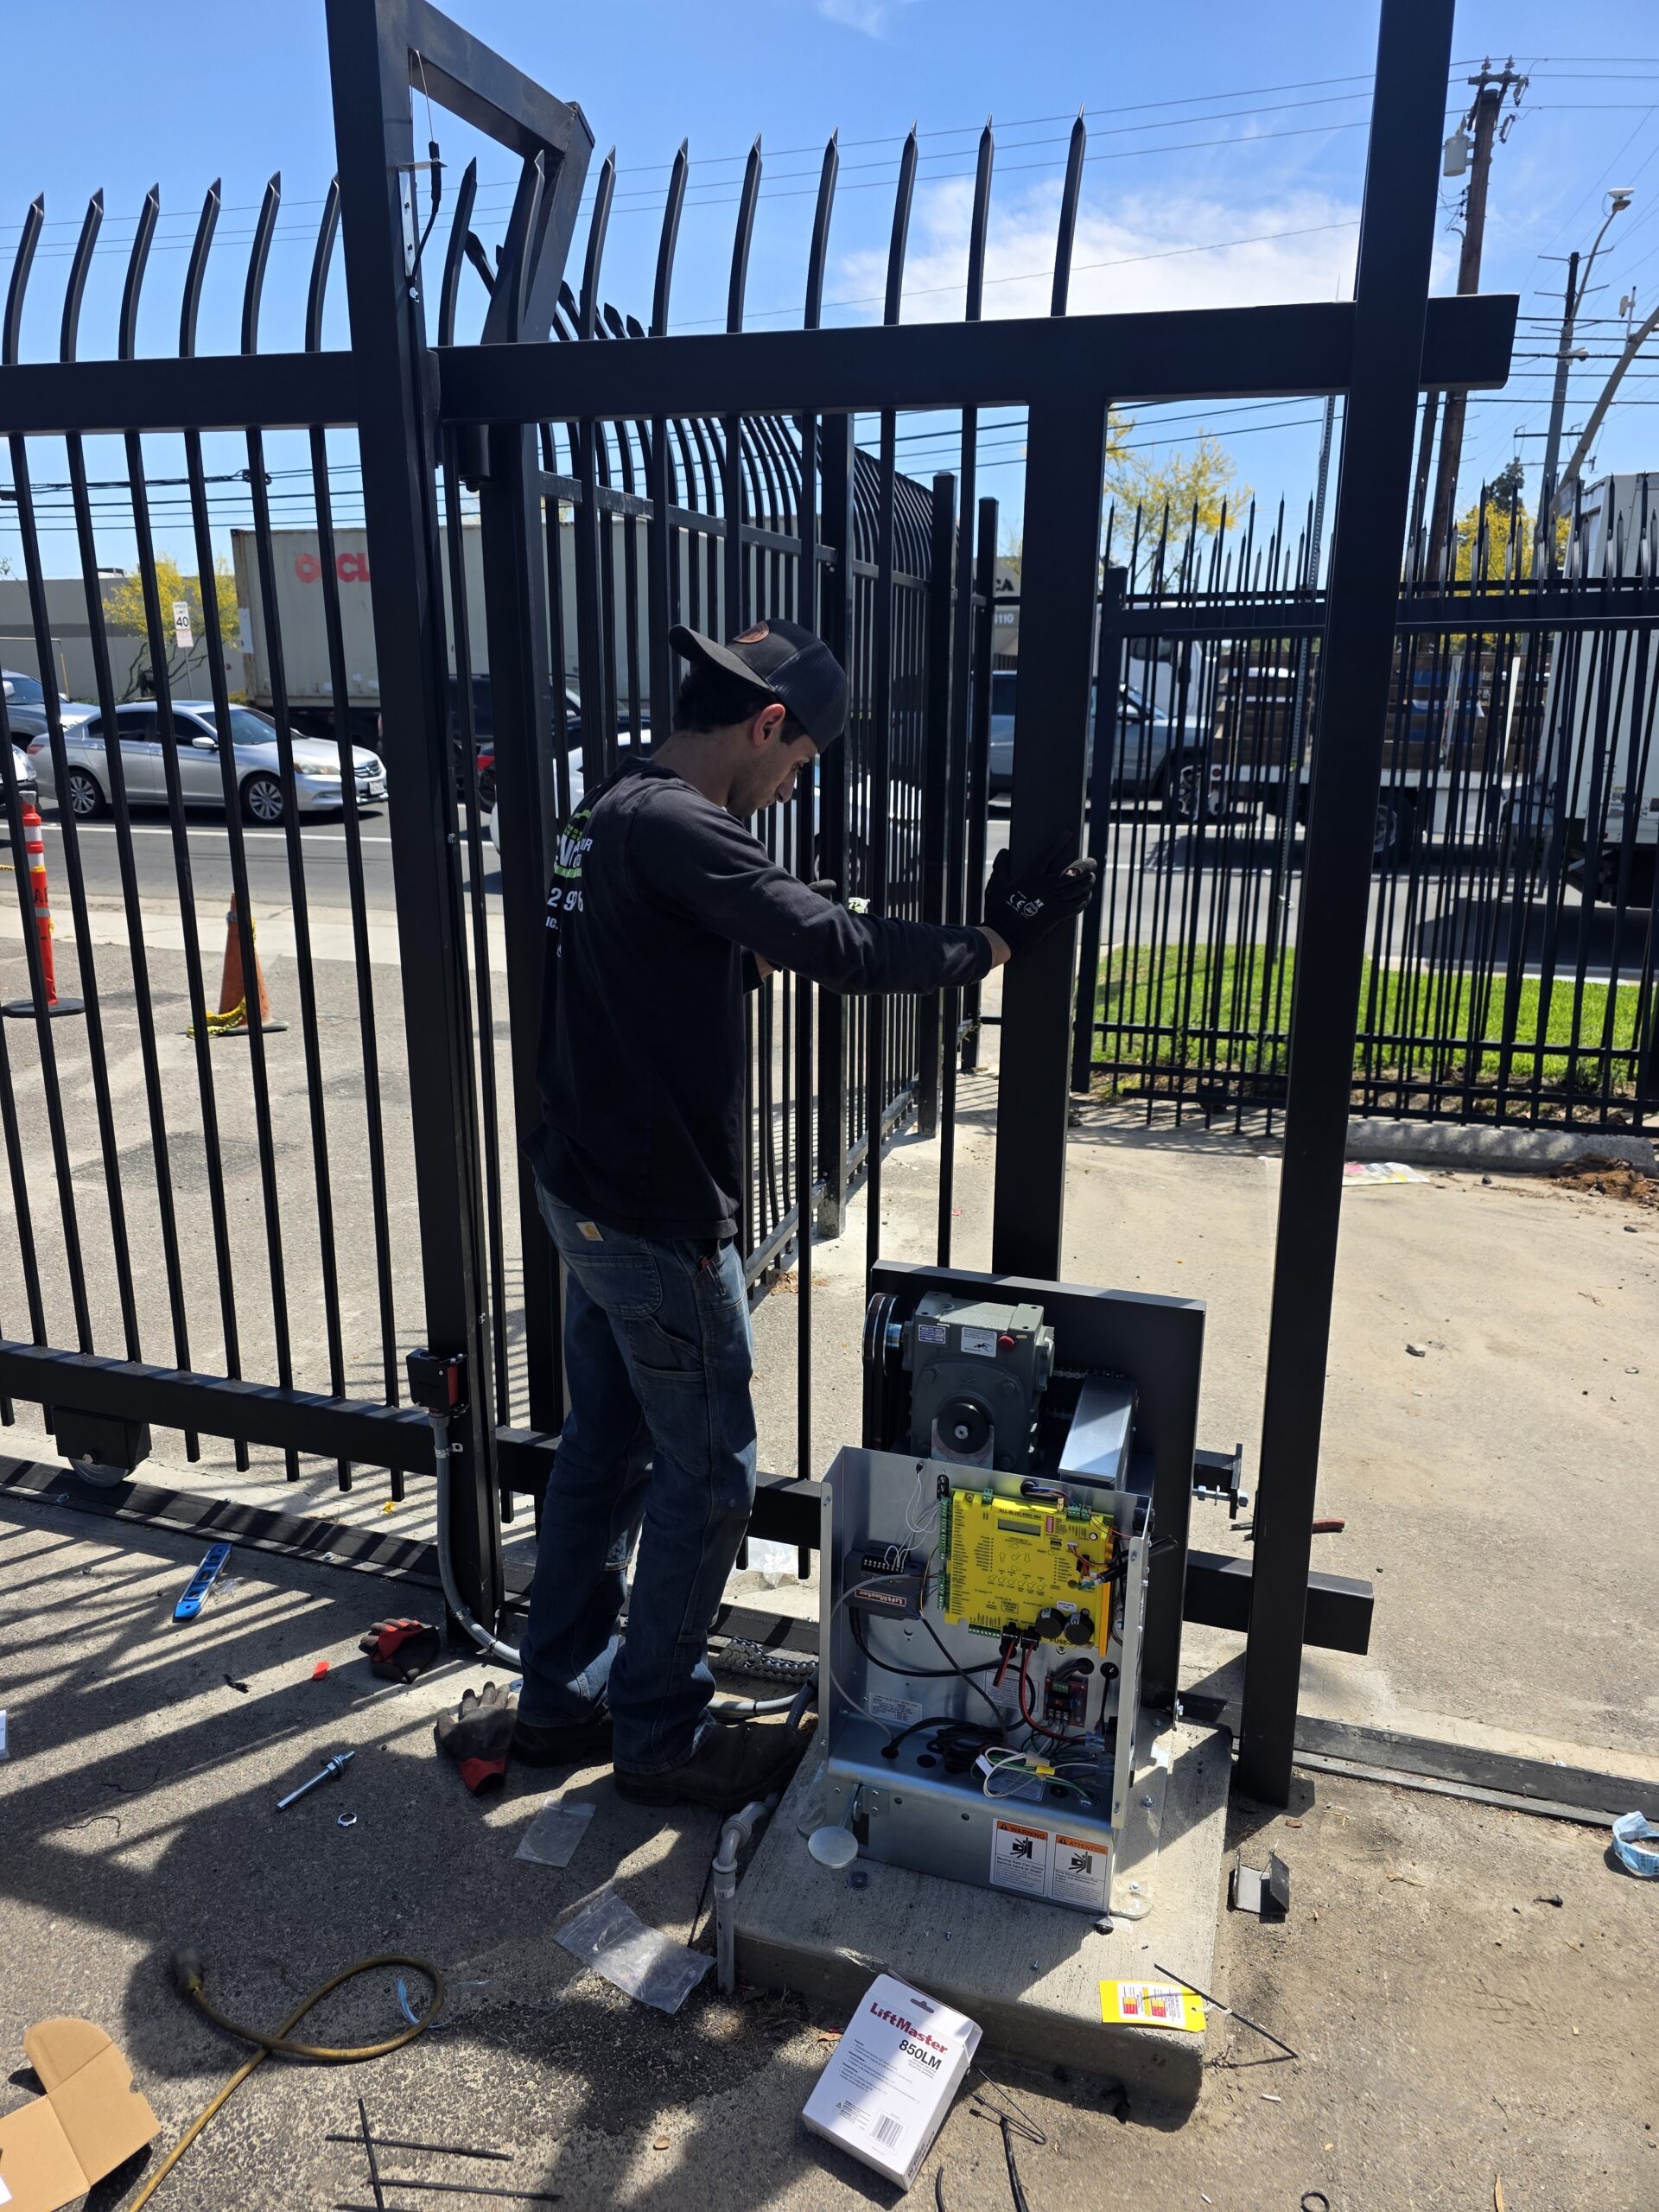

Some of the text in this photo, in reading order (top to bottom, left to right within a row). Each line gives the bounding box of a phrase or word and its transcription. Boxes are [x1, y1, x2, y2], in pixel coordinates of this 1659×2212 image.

[176, 616, 189, 627] 40
[1010, 1827, 1046, 1840] WARNING
[1069, 1840, 1106, 1855] ATTENTION
[869, 2002, 949, 2054] LiftMaster
[899, 2039, 942, 2070] 850LM
